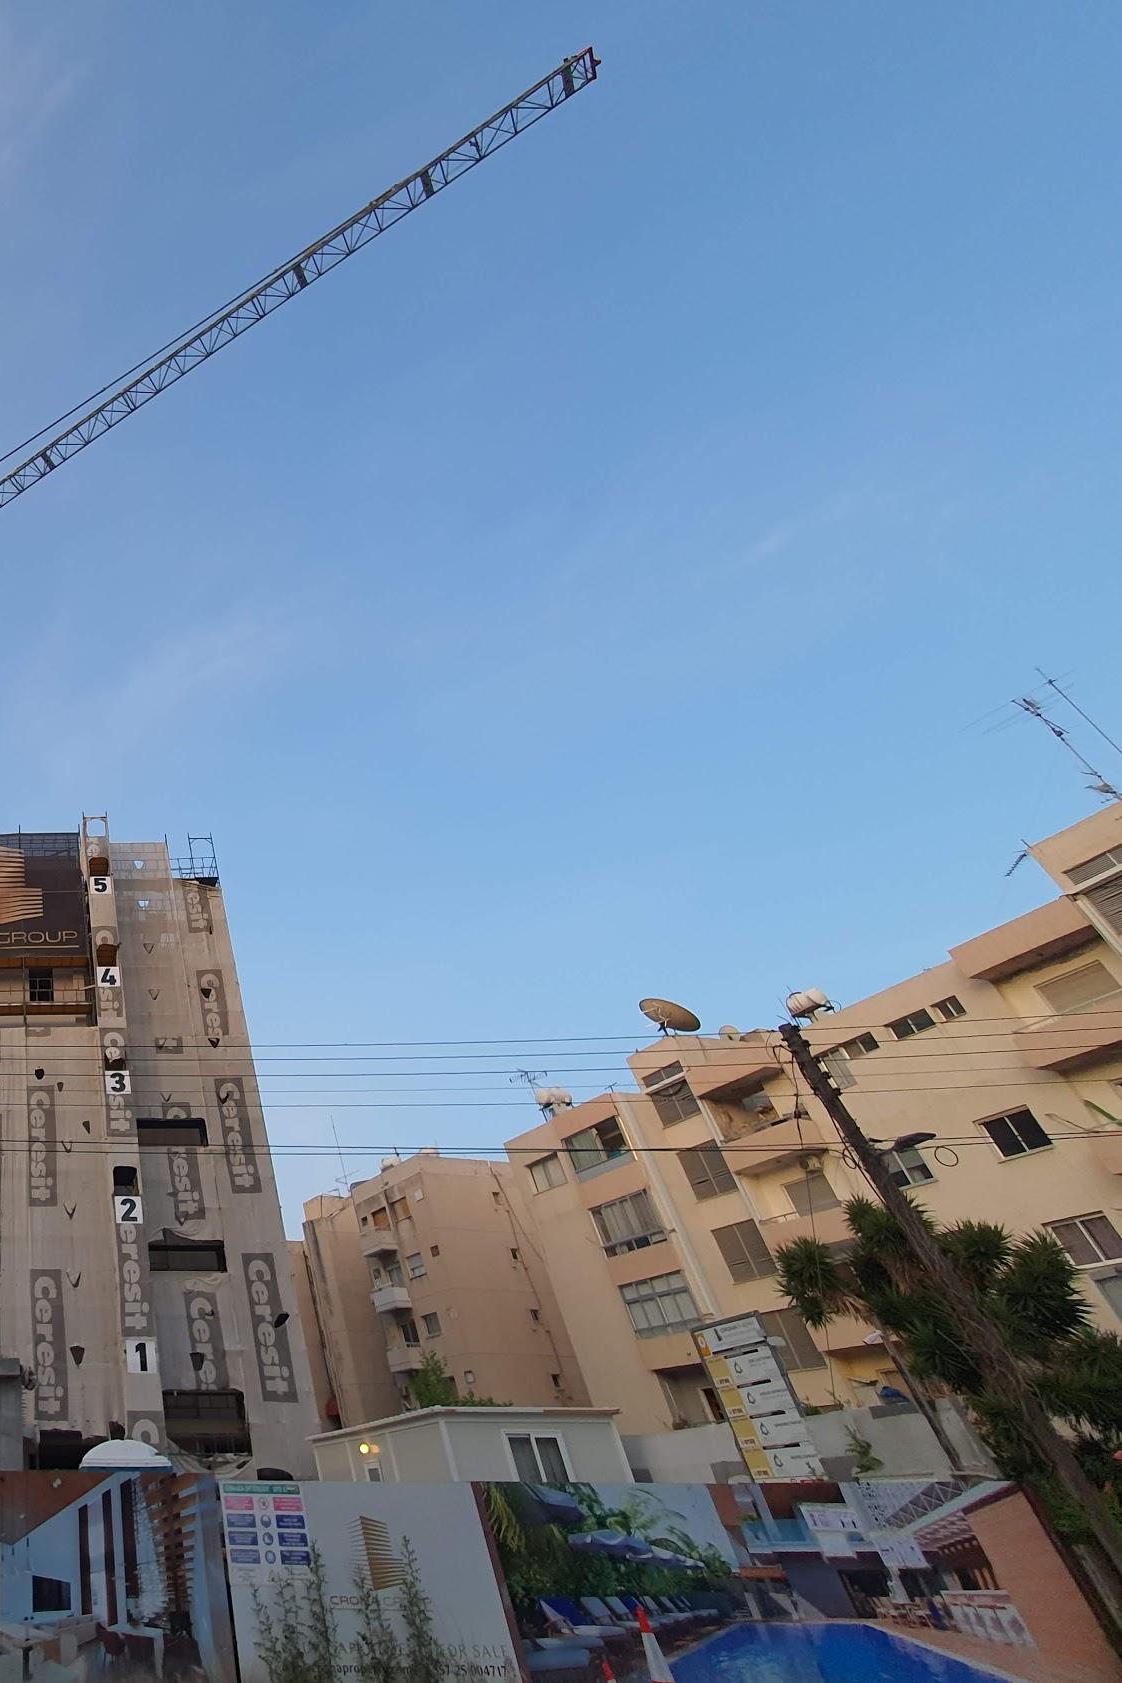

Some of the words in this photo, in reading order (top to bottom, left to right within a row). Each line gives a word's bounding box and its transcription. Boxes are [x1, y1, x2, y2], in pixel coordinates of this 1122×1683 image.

[94, 878, 107, 892] 5
[100, 968, 117, 985] 4
[200, 973, 223, 1038] Ceres
[110, 1072, 126, 1093] 3
[30, 1091, 53, 1200] Ceresit
[219, 1083, 255, 1188] Ceresit
[120, 1198, 138, 1222] 2
[119, 1224, 149, 1330] eresit
[34, 1276, 64, 1415] Ceresit
[248, 1259, 290, 1394] Ceresit
[135, 1342, 148, 1371] 1
[473, 1644, 507, 1658] SALE
